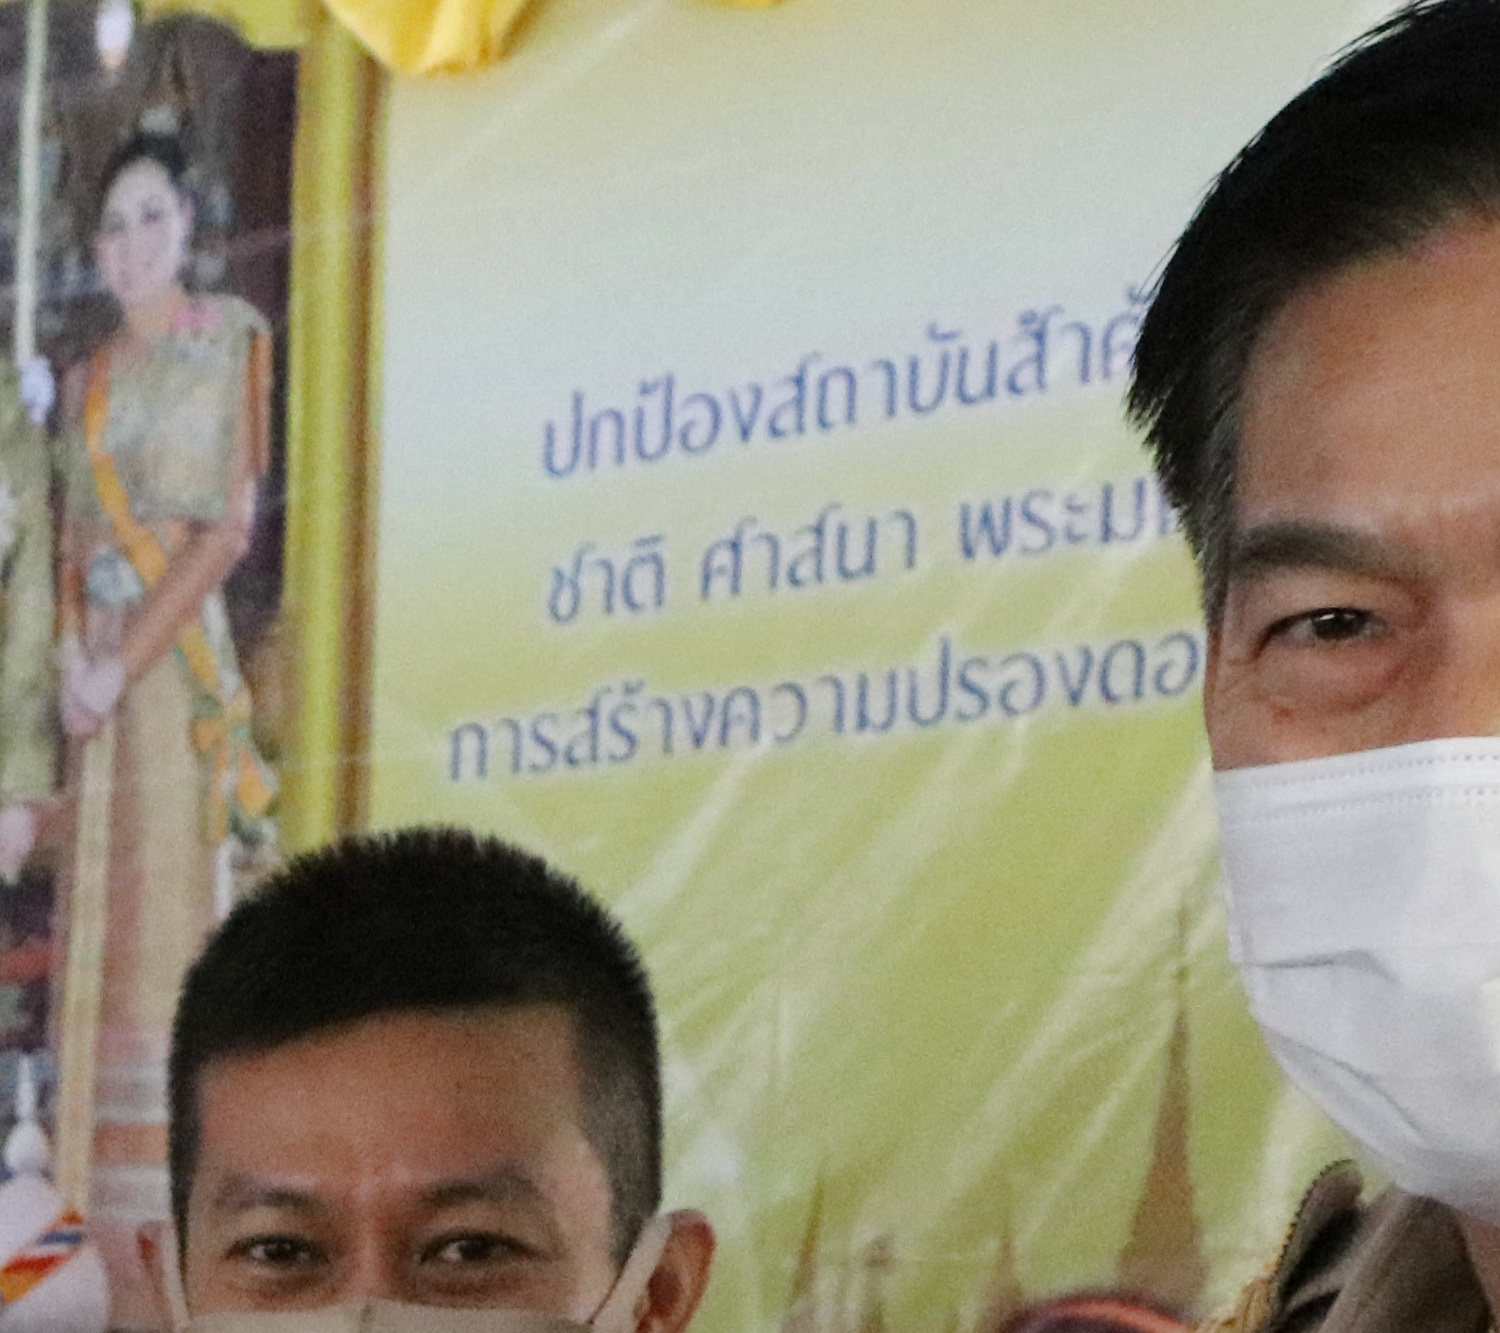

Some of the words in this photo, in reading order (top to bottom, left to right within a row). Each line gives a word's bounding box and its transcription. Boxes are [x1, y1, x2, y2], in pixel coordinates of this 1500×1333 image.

[547, 533, 668, 626] ชาติ
[698, 503, 918, 602] ศาสนา
[447, 629, 1201, 783] การสร้างความปรองดอ
